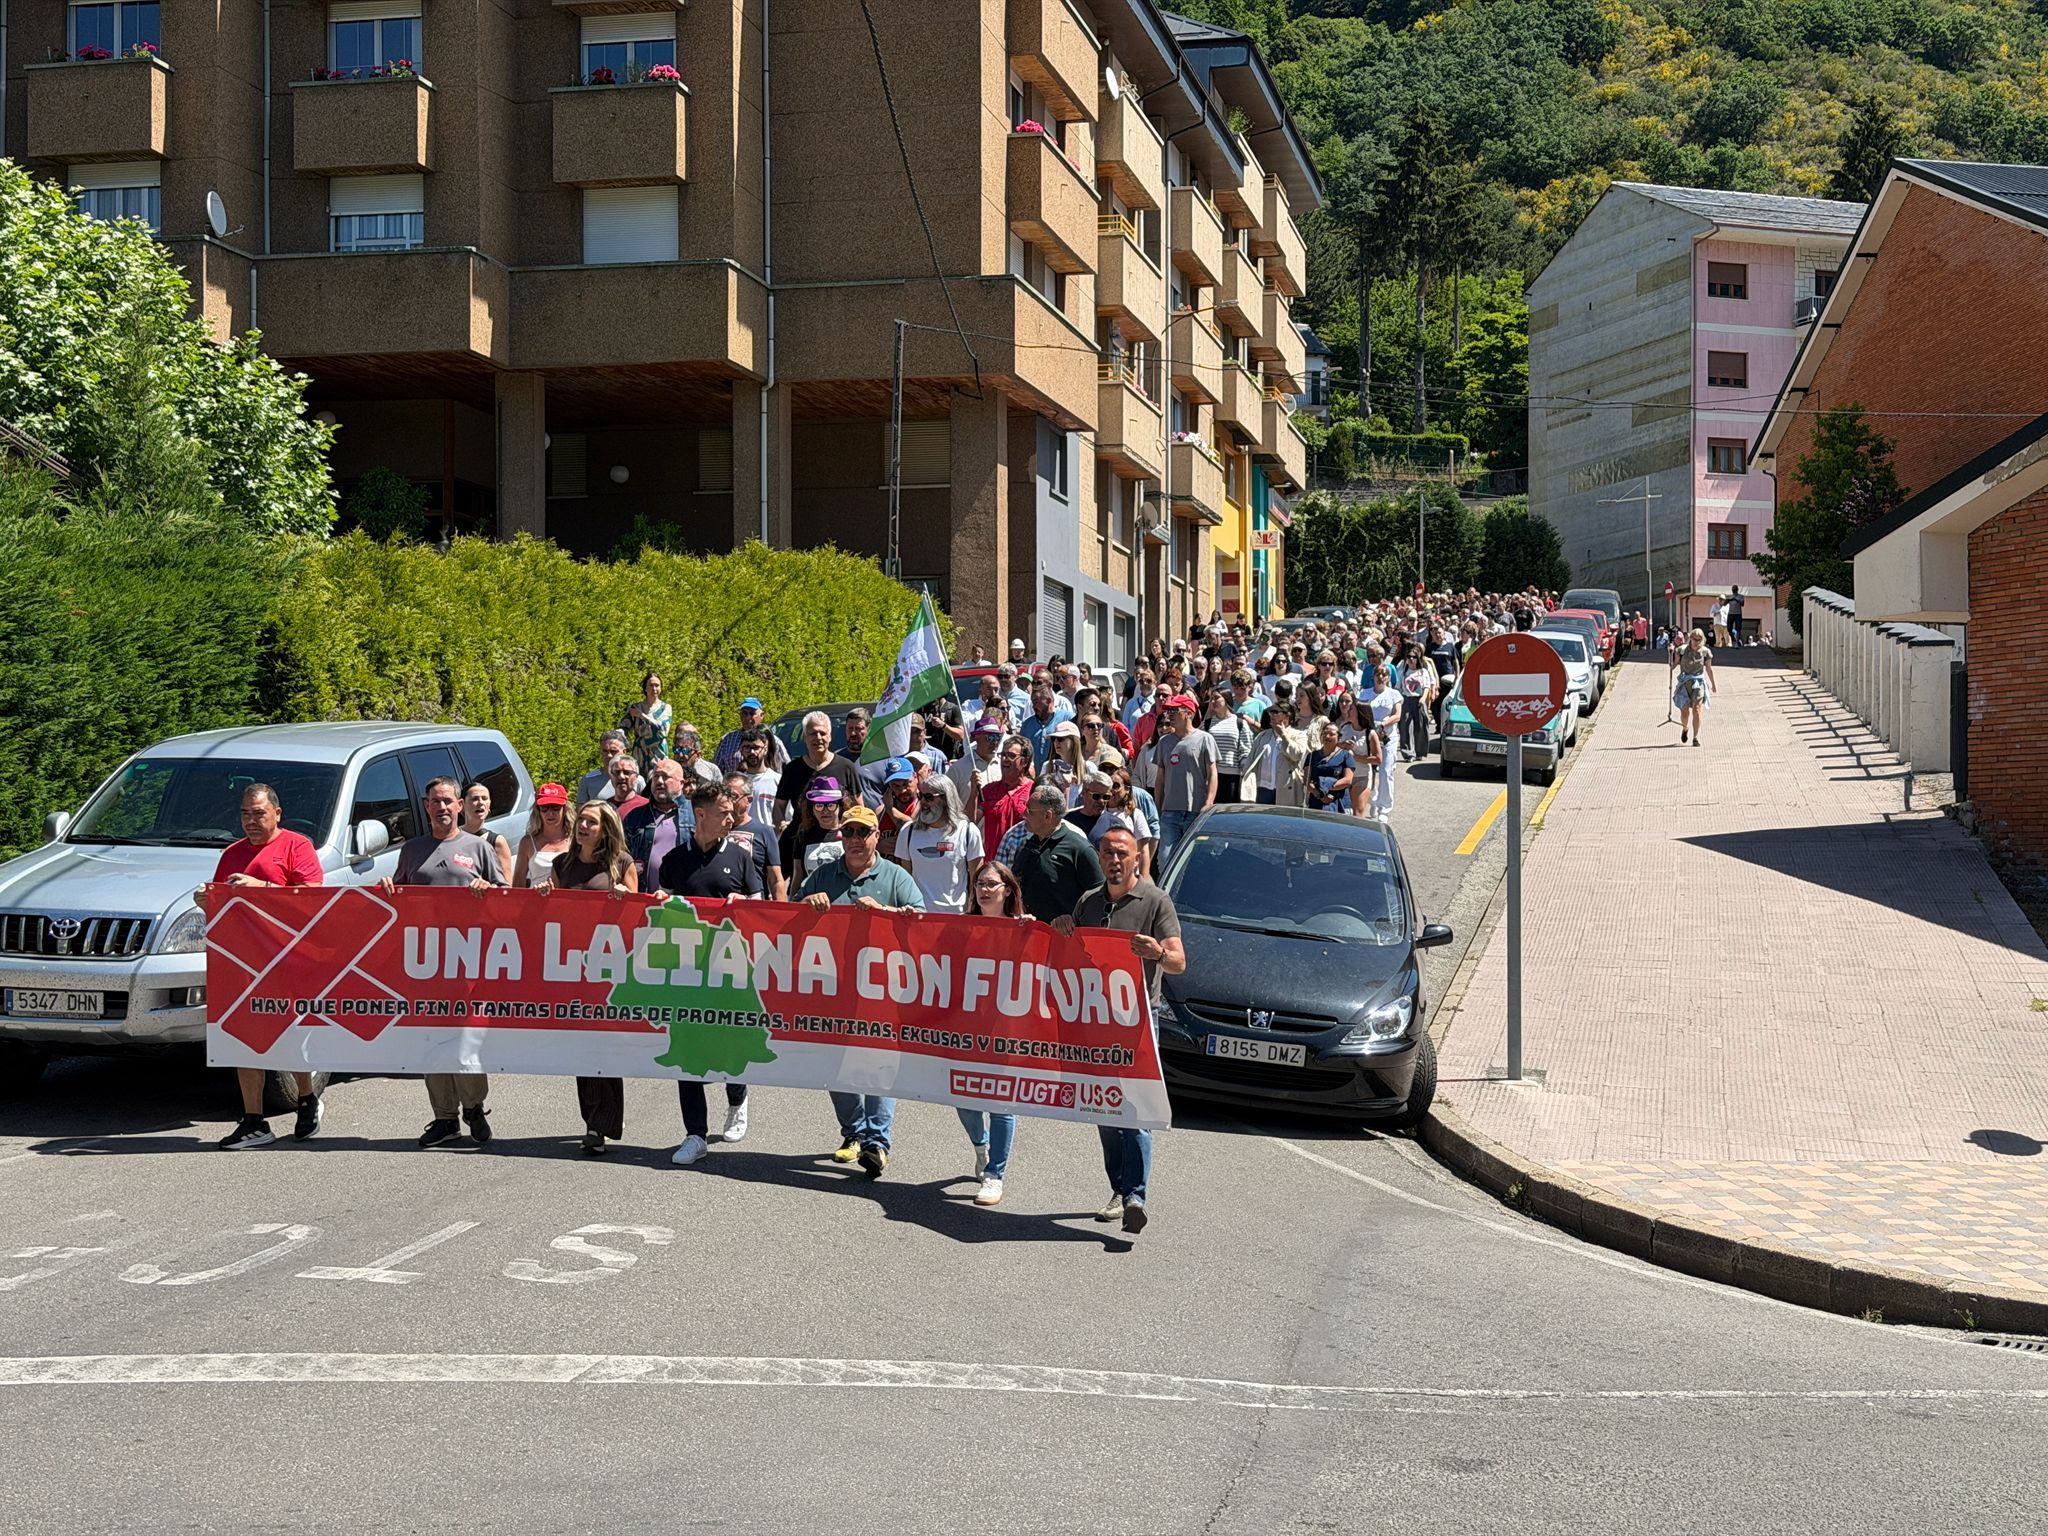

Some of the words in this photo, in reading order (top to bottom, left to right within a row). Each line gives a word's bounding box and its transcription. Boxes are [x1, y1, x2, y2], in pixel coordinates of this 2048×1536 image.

[404, 926, 523, 980] UNA
[543, 922, 838, 996] LACIANA
[856, 946, 951, 1009] CON
[963, 957, 1140, 1027] FUTURO
[18, 992, 58, 1011] 5347
[67, 993, 98, 1012] DHN
[251, 998, 290, 1015] HAY
[295, 999, 336, 1015] QUE
[341, 999, 410, 1016] PONER
[415, 1000, 450, 1016] FIN
[453, 1000, 467, 1016] A
[472, 1001, 550, 1018] TANTAS
[555, 1000, 646, 1021] DÉCADAS
[647, 1006, 672, 1021] DE
[677, 1008, 790, 1031] PROMESAS,
[794, 1014, 898, 1041] MENTIRAS,
[900, 1026, 973, 1050] EXCUSAS
[977, 1036, 990, 1051] Y
[994, 1036, 1134, 1066] DISCRIMINACIÓN
[1219, 1038, 1259, 1058] 8155
[1267, 1045, 1301, 1064] DMZ
[953, 1074, 1012, 1096] CCOO
[1019, 1081, 1060, 1104] UGT
[1080, 1082, 1124, 1108] USO
